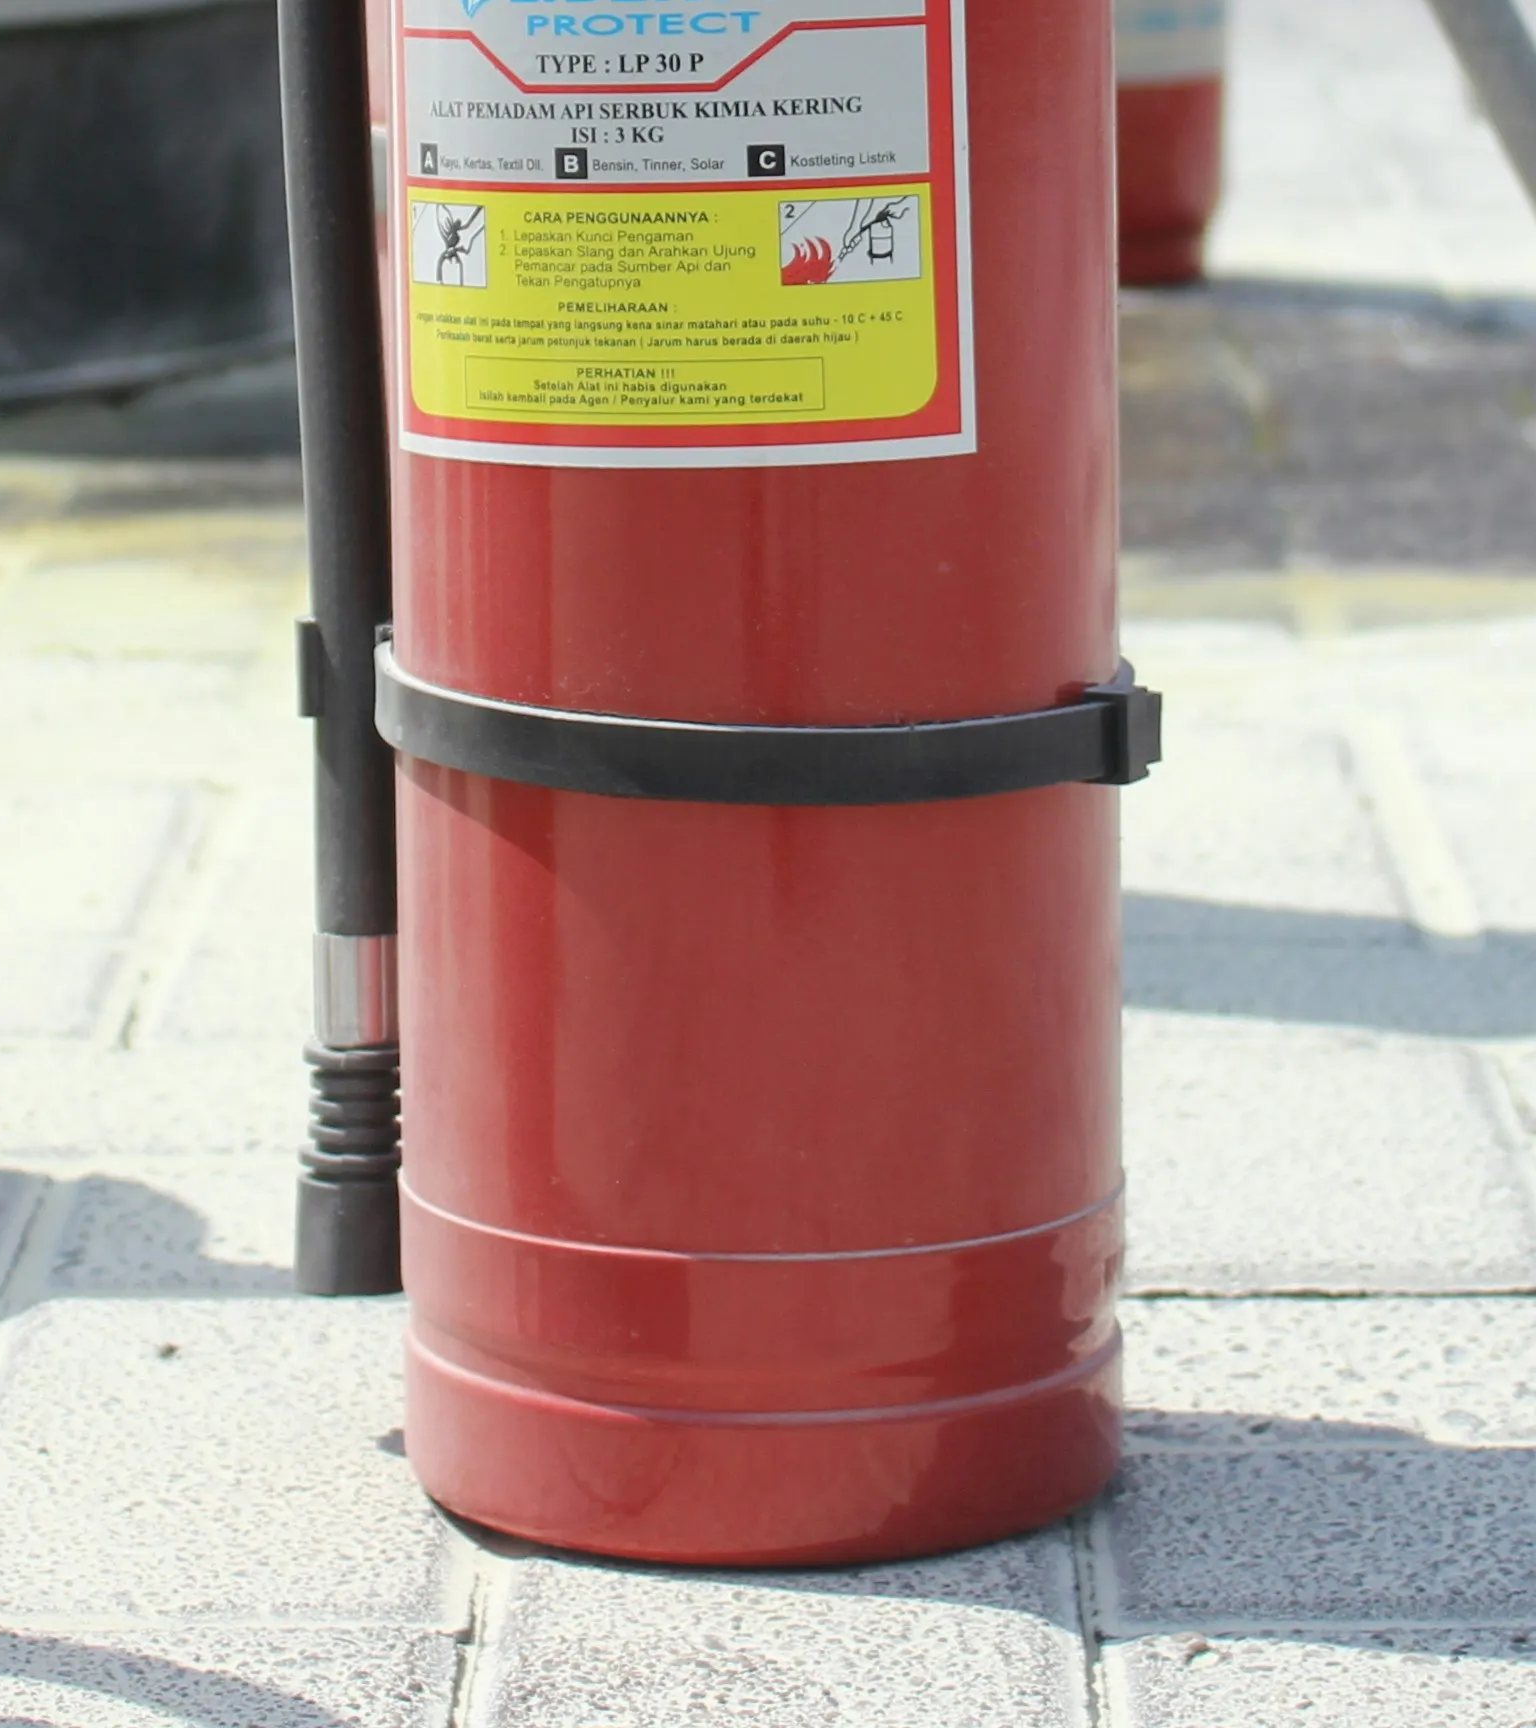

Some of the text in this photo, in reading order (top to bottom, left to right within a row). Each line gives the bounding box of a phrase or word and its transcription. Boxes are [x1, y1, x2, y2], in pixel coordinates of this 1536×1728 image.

[526, 11, 761, 36] PROTECT
[535, 54, 596, 74] TYPE
[618, 54, 649, 74] LP
[655, 53, 681, 73] 30
[688, 53, 704, 72] P
[429, 96, 863, 120] ALAT PEMADAM API SERBUK KIMIA KERING
[571, 126, 598, 144] ISI
[615, 126, 626, 144] 3
[631, 126, 665, 144] KG
[563, 154, 580, 173] B
[592, 159, 638, 173] Bensin,
[643, 158, 686, 173] Tinner,
[690, 158, 725, 171] Solar
[758, 150, 777, 169] C
[790, 152, 855, 169] Kostleting
[859, 149, 896, 166] Listrik
[524, 211, 562, 224] CARA
[566, 211, 709, 224] PENGGUNAANNYA
[784, 204, 795, 219] 2
[514, 230, 572, 244] Lepaskan
[576, 229, 613, 242] Kunci
[617, 230, 694, 245] Pengaman
[514, 245, 572, 259] Lepaskan
[577, 245, 614, 260] Slang
[618, 245, 644, 258] dan
[648, 244, 708, 258] Arahkan
[713, 243, 756, 259] Ujung
[514, 258, 732, 274] Pemancar pada Sumber Api dan
[515, 276, 641, 290] Tekan Pengatupnya
[558, 301, 668, 314] PEMELIHARAAN
[547, 319, 571, 332] yang
[574, 319, 623, 332] langsung
[626, 319, 652, 331] kena
[656, 319, 683, 330] sinar
[687, 318, 738, 330] matahari
[741, 318, 766, 330] atau
[770, 317, 798, 331] pada
[802, 316, 830, 328] suhu
[841, 314, 855, 326] 10
[895, 310, 903, 322] C
[594, 337, 636, 348] tekanan
[646, 337, 681, 348] Jarum
[686, 336, 718, 348] harus
[722, 335, 762, 347] berada
[765, 334, 776, 346] di
[780, 333, 820, 346] daerah
[823, 331, 851, 346] hijau
[576, 367, 656, 379] PERHATIAN
[533, 379, 727, 394] Setelah Alat ini habis digunakan
[549, 394, 576, 407] pada
[579, 394, 609, 408] Agen
[620, 393, 675, 408] Penyalur
[679, 393, 710, 405] kami
[714, 394, 745, 407] yang
[750, 391, 804, 404] terdekat
